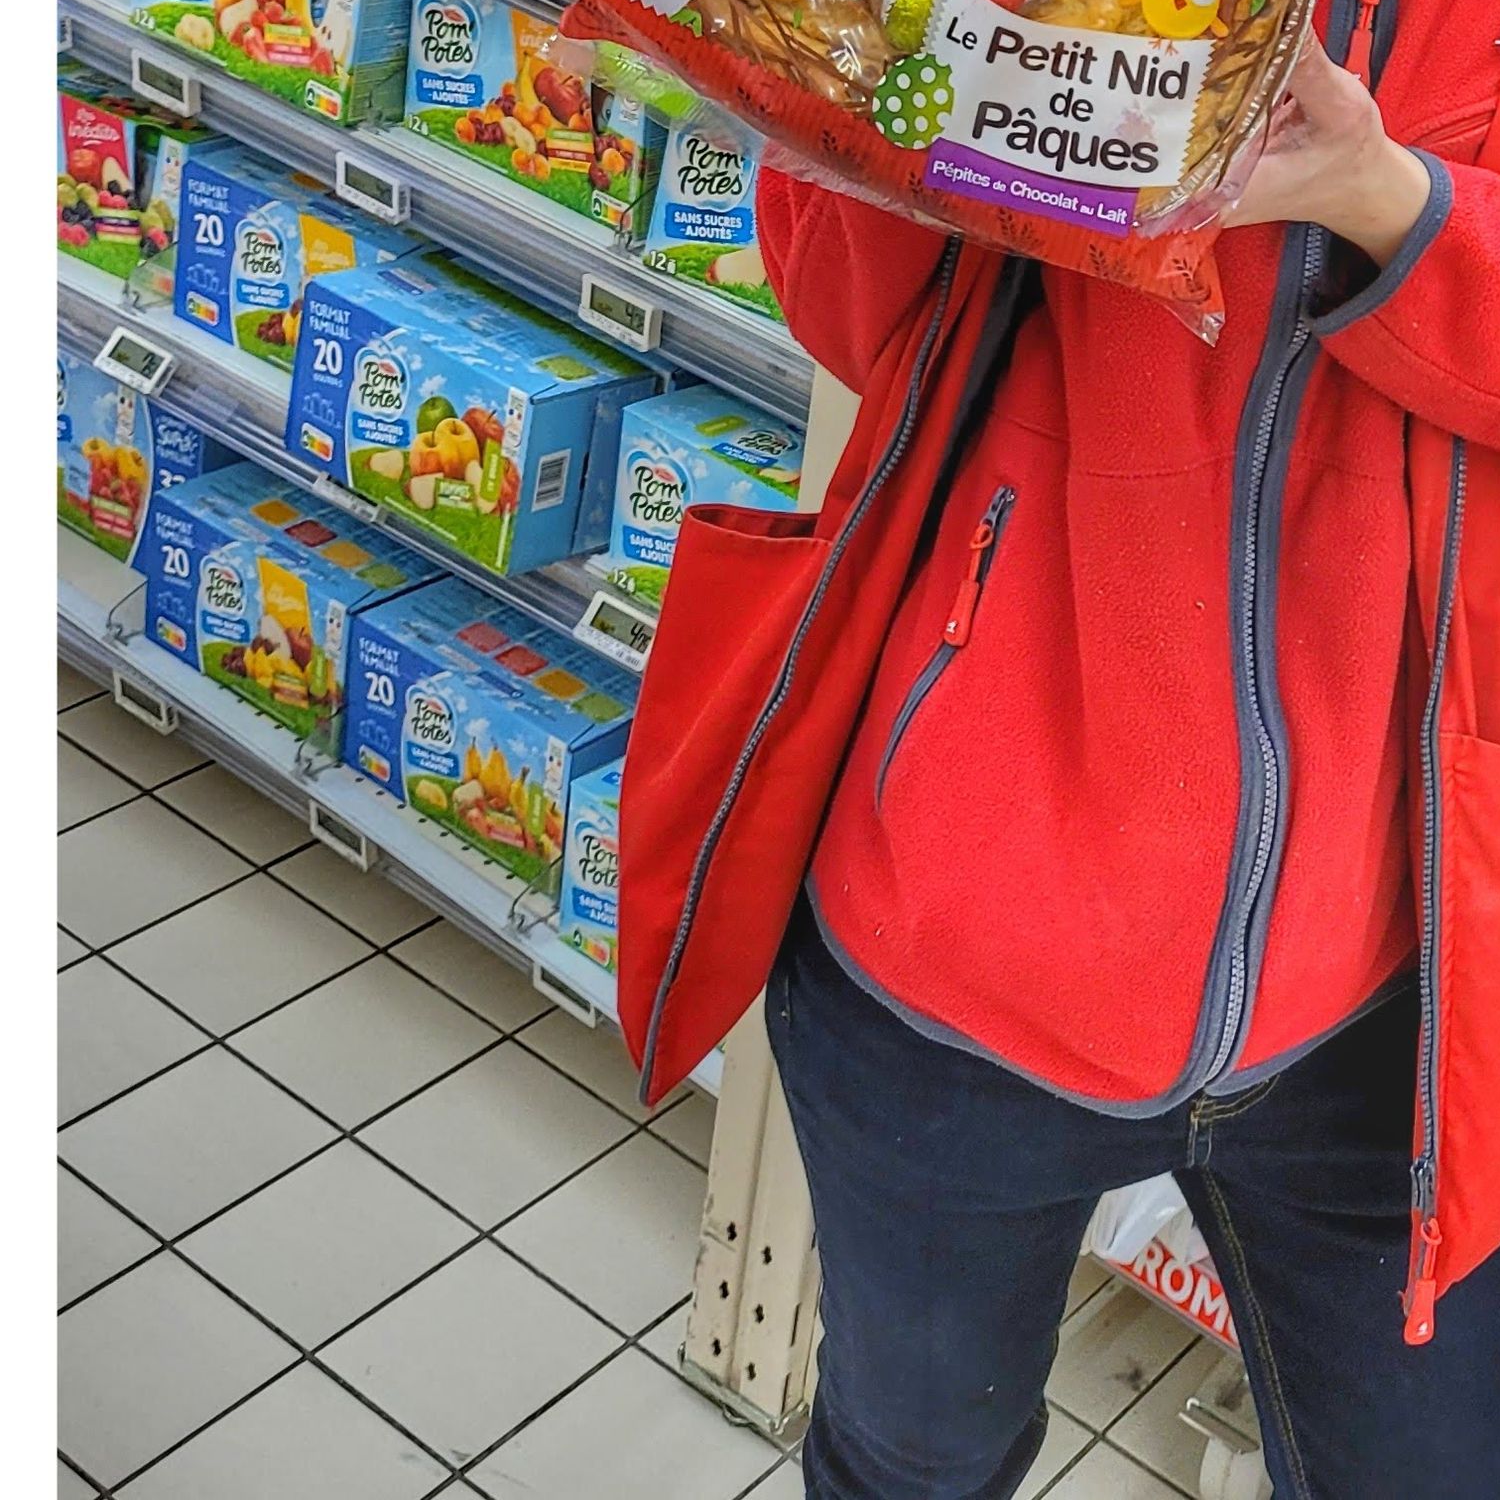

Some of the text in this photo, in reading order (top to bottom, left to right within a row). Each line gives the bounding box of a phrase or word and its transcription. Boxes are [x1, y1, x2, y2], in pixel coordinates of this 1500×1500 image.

[421, 37, 474, 65] Potes
[944, 14, 1192, 102] Le Petit Nid
[1049, 89, 1096, 124] de
[970, 98, 1162, 175] Pâques
[678, 162, 745, 197] Potes
[931, 159, 992, 188] Pépites
[1009, 180, 1080, 213] Chocolat
[1097, 205, 1129, 227] Lait
[193, 213, 224, 247] 20
[674, 209, 743, 229] SANS SUCRES
[648, 249, 668, 271] 12
[312, 338, 344, 375] 20
[358, 382, 404, 410] Potes
[160, 544, 190, 579] 20
[364, 670, 395, 707] 20
